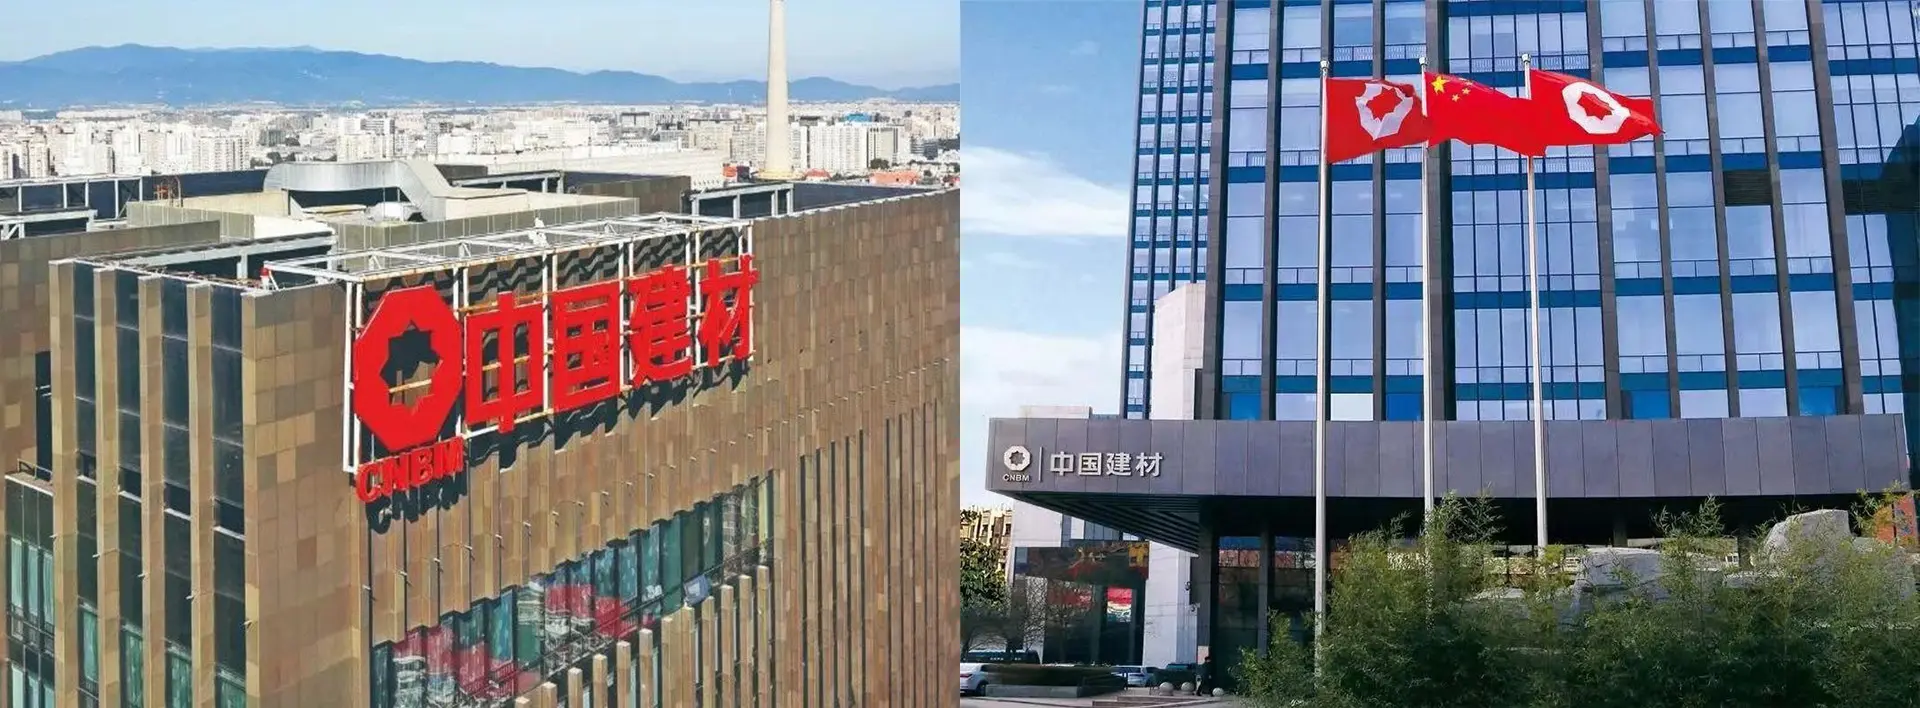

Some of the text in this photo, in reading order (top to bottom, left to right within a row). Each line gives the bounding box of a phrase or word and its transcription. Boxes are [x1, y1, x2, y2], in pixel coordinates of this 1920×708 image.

[465, 254, 759, 433] 中国建材
[356, 436, 464, 503] CNBM
[1002, 473, 1030, 482] CNBM
[1050, 451, 1163, 477] 中国建材
